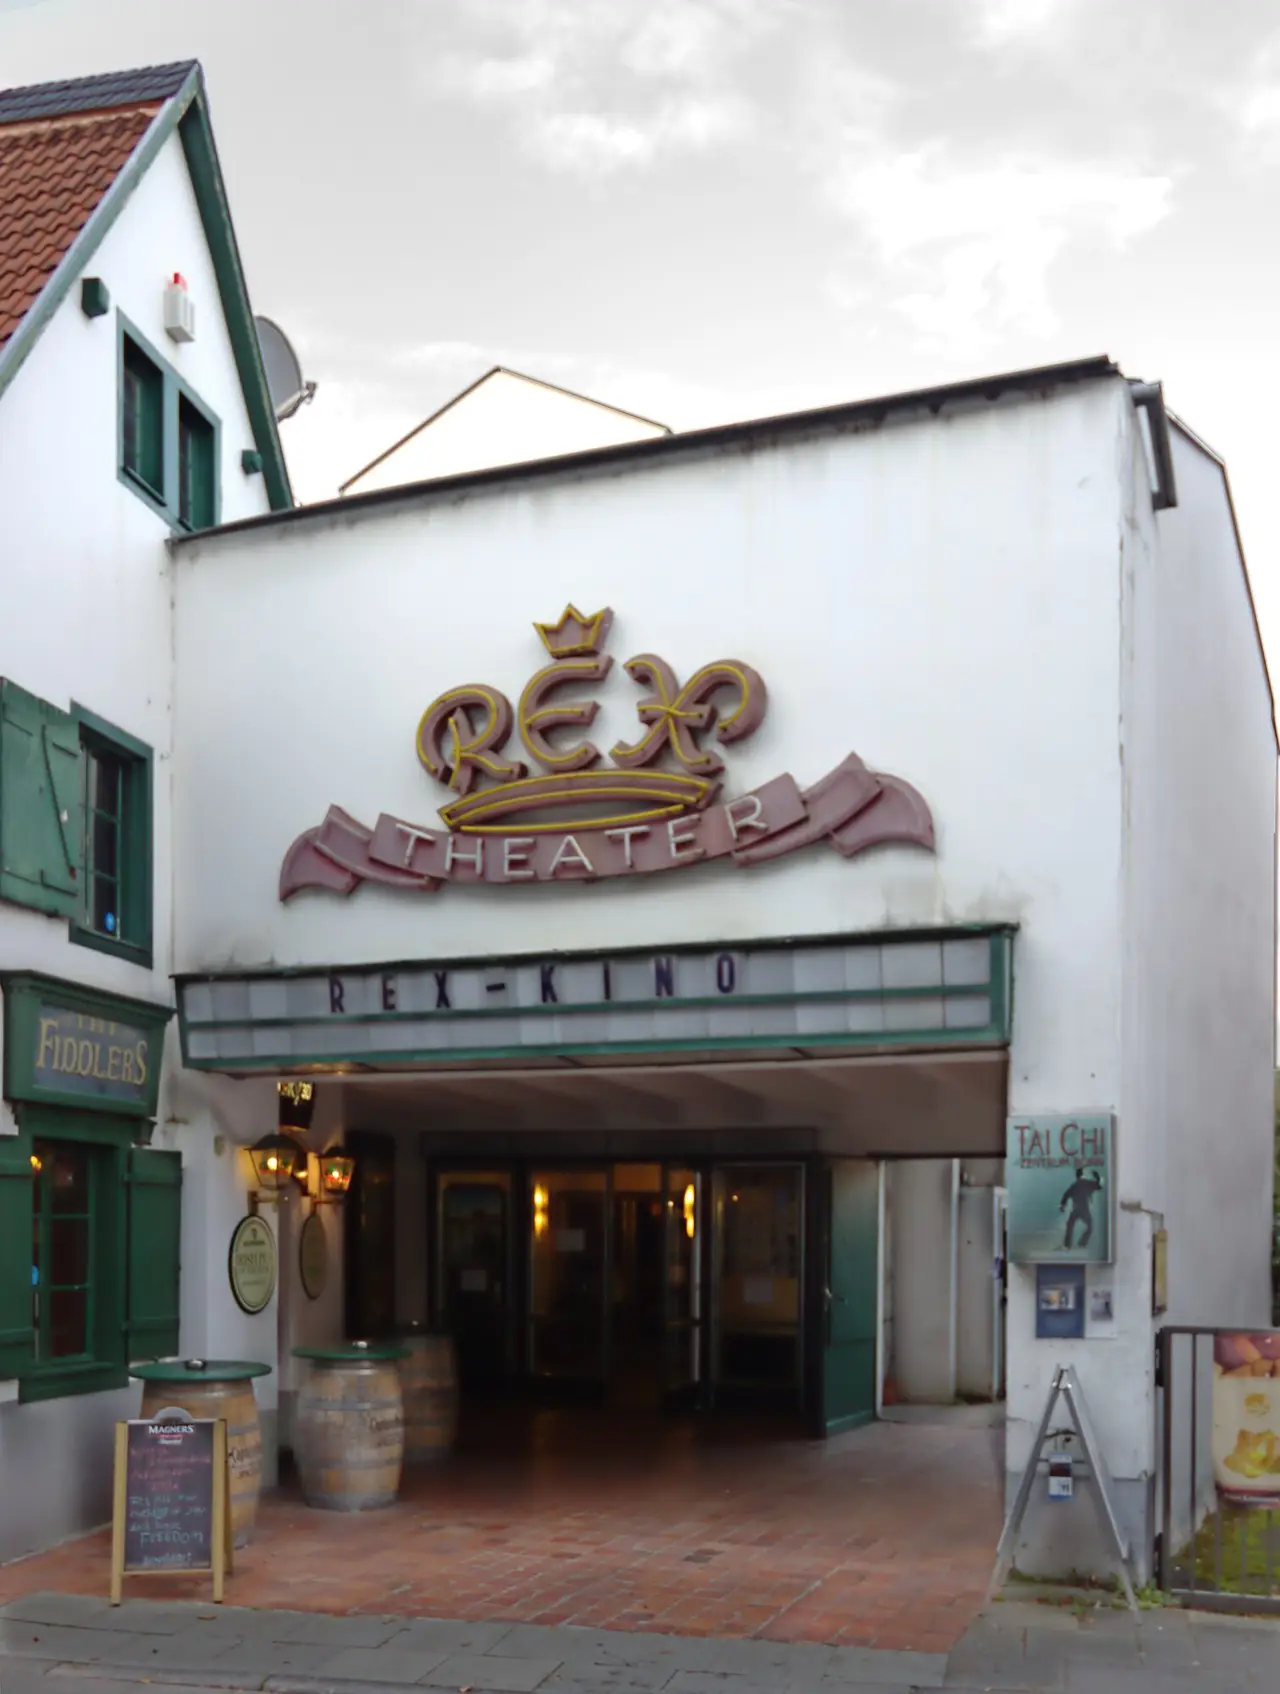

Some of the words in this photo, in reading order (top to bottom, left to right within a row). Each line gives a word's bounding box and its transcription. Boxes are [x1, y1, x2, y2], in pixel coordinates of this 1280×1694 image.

[416, 653, 768, 796] REX
[395, 795, 769, 878] THEATER
[36, 1018, 148, 1085] FIDDLERS
[1013, 1125, 1051, 1159] TAI
[1059, 1122, 1105, 1157] CHI
[148, 1424, 195, 1434] MAGNERS
